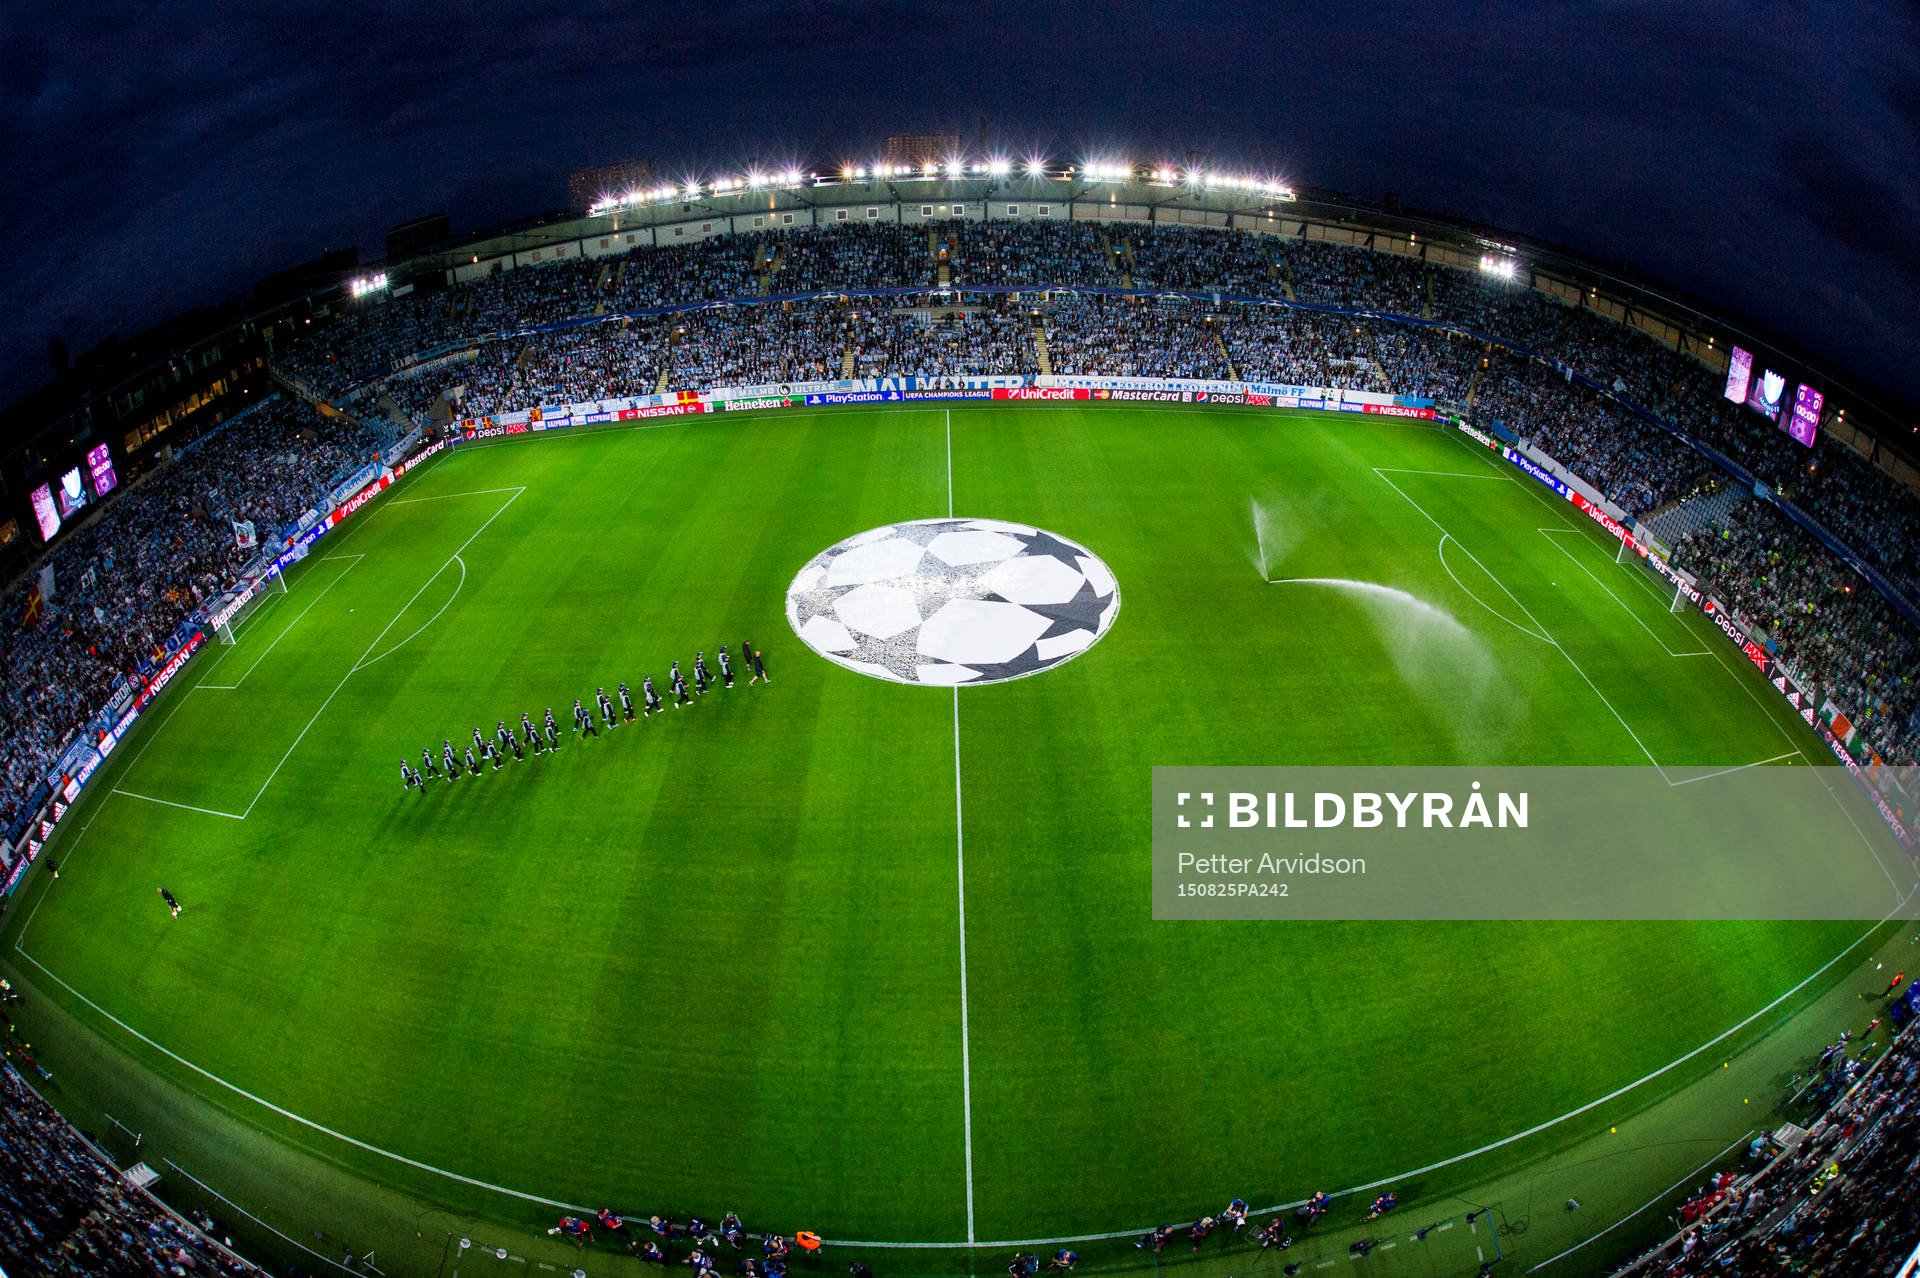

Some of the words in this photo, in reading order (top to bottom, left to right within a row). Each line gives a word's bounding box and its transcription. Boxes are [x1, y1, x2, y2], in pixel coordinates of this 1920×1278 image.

[826, 392, 883, 404] PlayStation
[924, 391, 963, 399] CHAMPIONS
[965, 390, 990, 398] LEAGUE
[1021, 388, 1075, 400] UniCredit
[1111, 390, 1180, 401] MasterCard
[1251, 384, 1287, 396] Malmö
[1291, 387, 1305, 397] FF
[725, 398, 781, 411] Heineken
[1210, 394, 1244, 404] pepsi
[1245, 395, 1272, 407] MAX
[637, 406, 685, 418] NISSAN
[1379, 406, 1418, 418] NISSAN
[478, 426, 504, 439] pepsi
[506, 422, 528, 435] MAX
[1458, 419, 1491, 451] Heineken
[404, 440, 445, 472] MasterCard
[1519, 457, 1555, 487] PlayStation
[348, 482, 382, 512] UniCredit
[1588, 504, 1625, 541] UniCredit
[1715, 614, 1745, 646] pepsi
[1743, 641, 1770, 673] MAX
[150, 648, 191, 696] NISSAN
[1831, 739, 1861, 776] RESPECT
[1877, 799, 1906, 838] RESPECT
